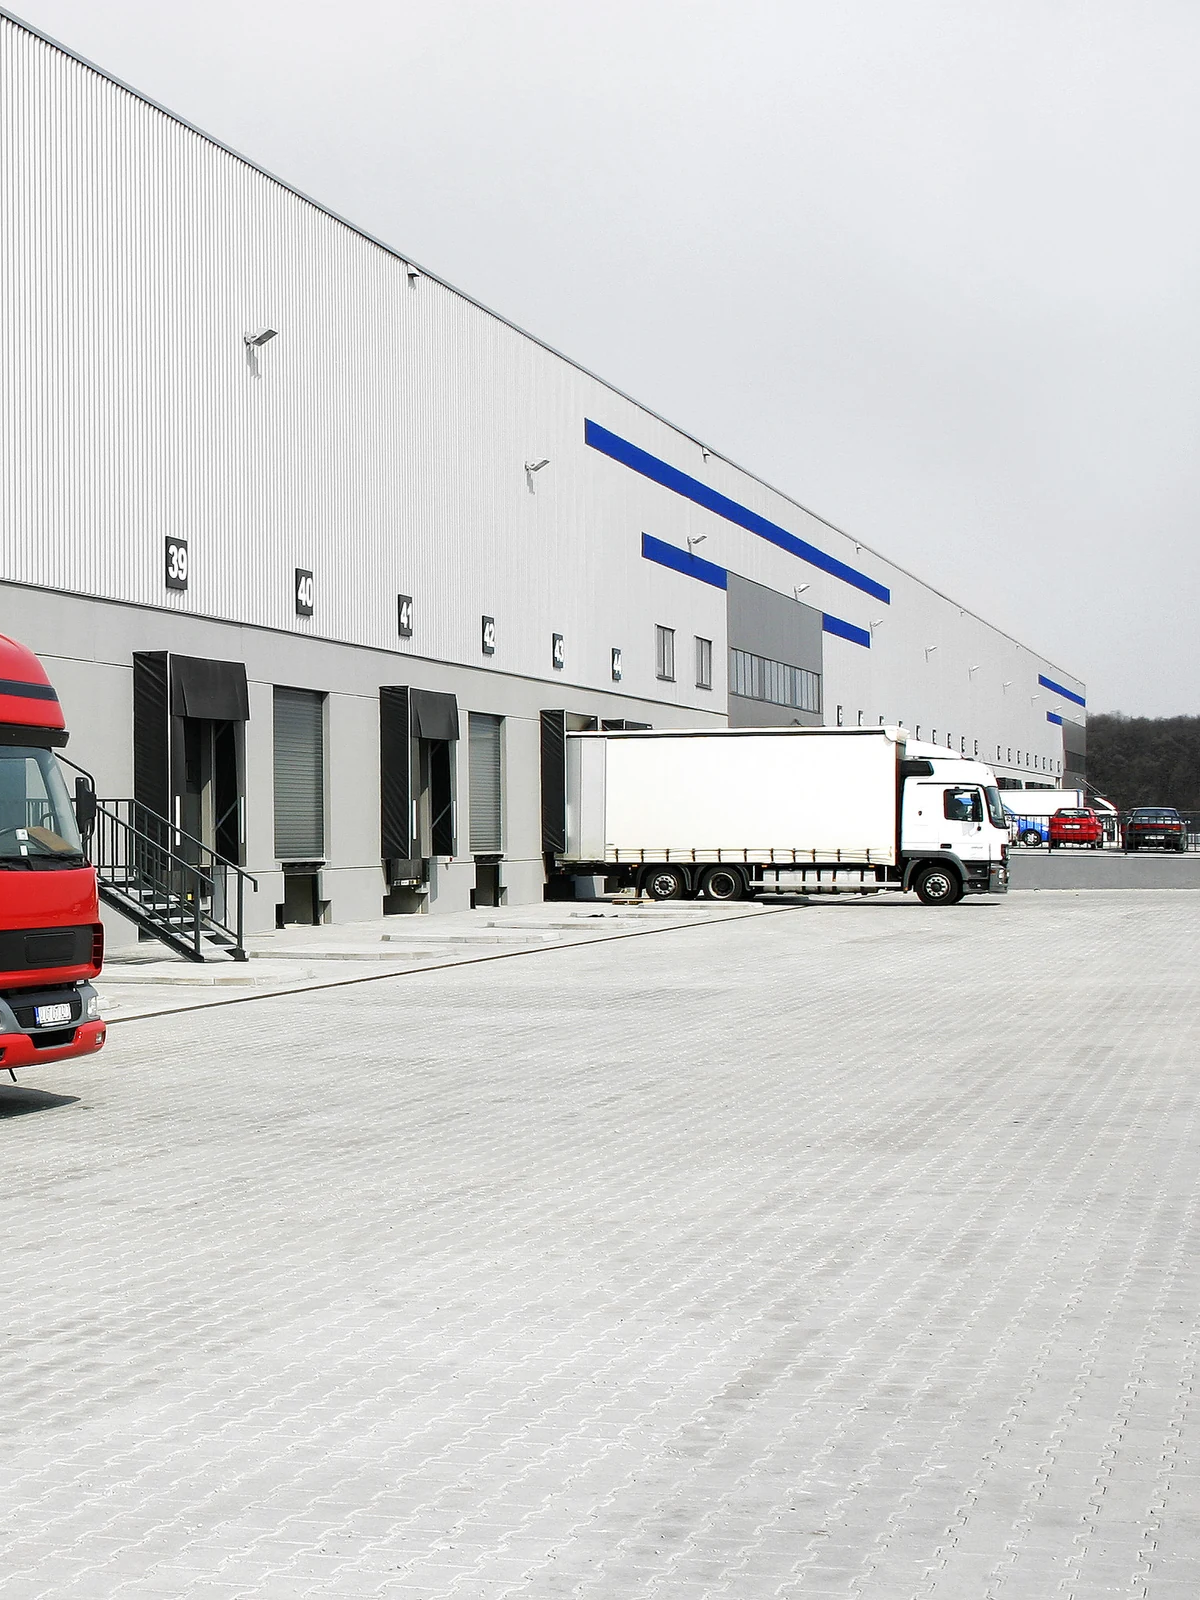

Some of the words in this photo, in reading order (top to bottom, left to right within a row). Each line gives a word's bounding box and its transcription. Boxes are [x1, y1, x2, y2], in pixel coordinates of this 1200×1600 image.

[168, 544, 188, 581] 39
[297, 576, 313, 607] 40
[400, 601, 413, 630] 41
[484, 622, 495, 647] 42
[554, 639, 564, 662] 43
[613, 653, 621, 675] 44
